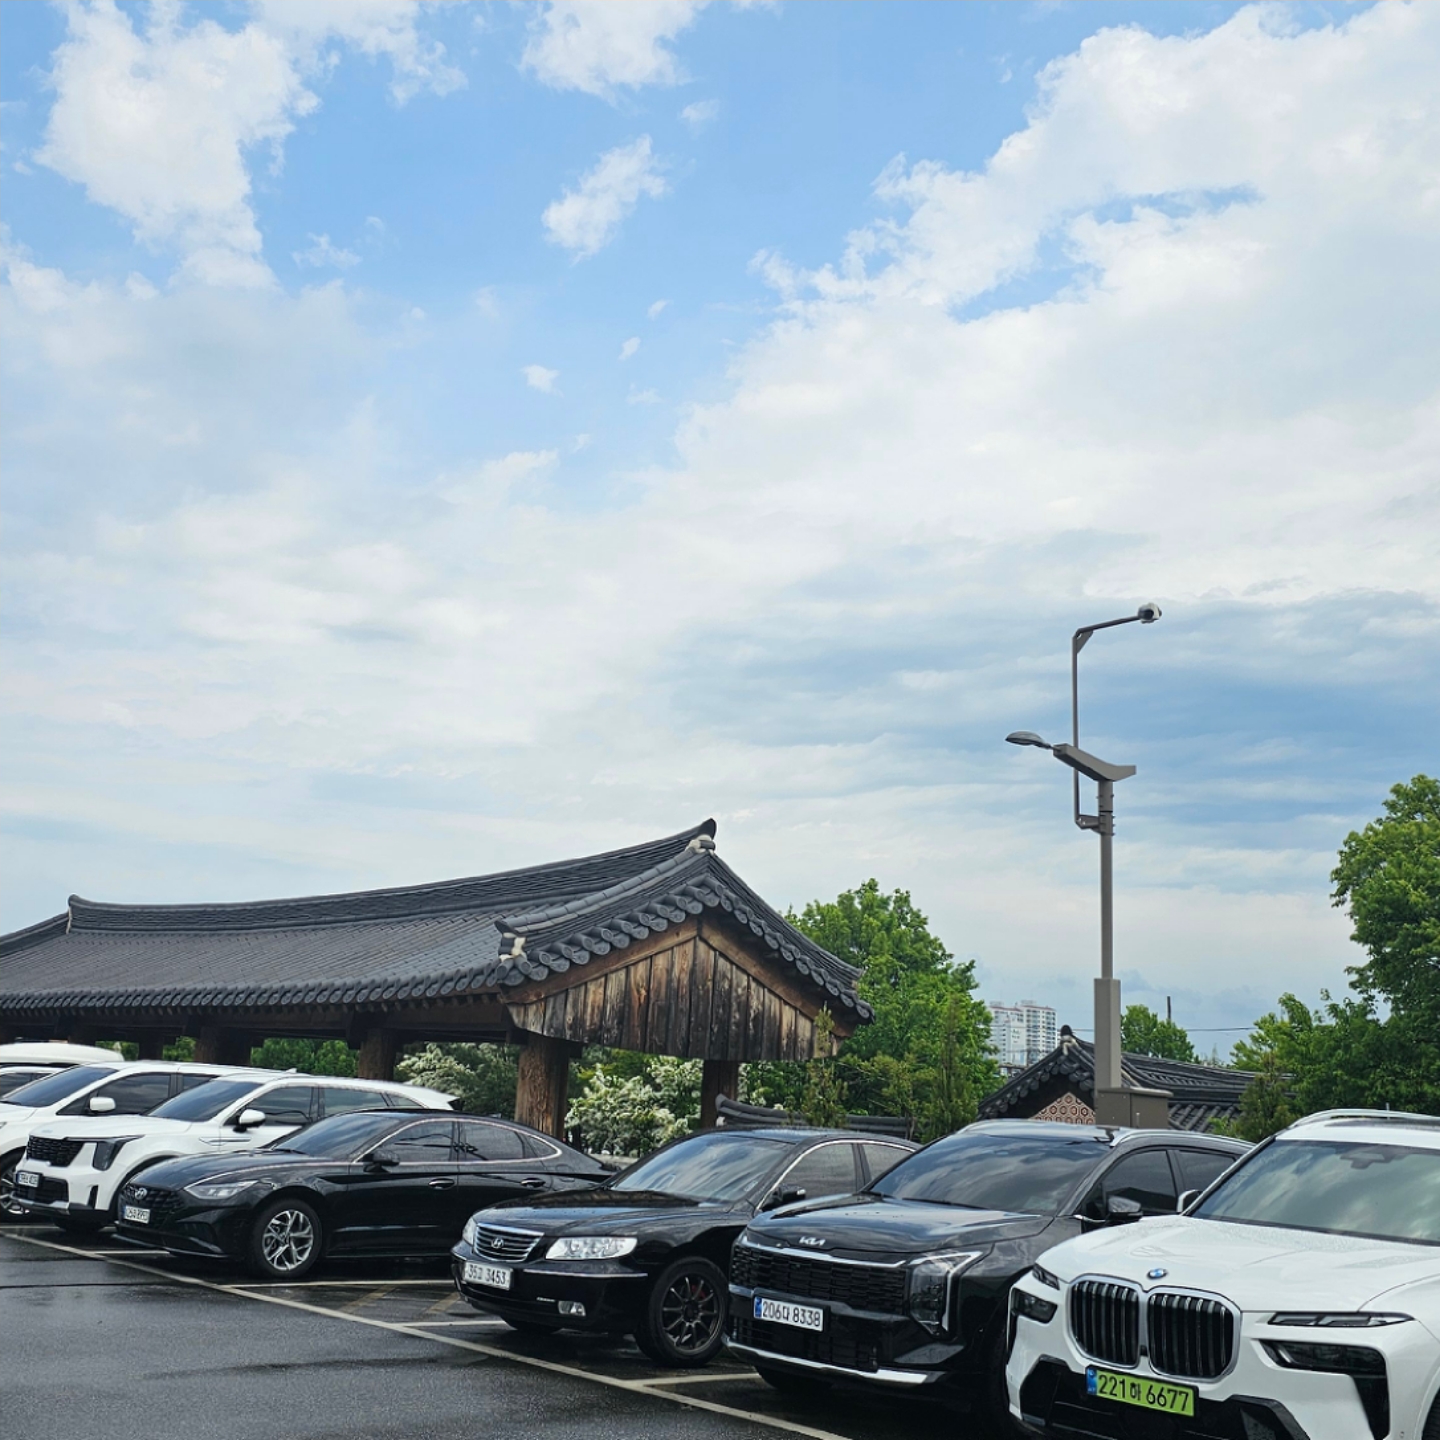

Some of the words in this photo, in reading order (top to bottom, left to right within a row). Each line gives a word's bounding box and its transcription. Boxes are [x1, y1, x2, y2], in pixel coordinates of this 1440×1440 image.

[792, 1307, 821, 1327] 8338
[1098, 1374, 1142, 1401] 221하
[1146, 1385, 1189, 1412] 6677
